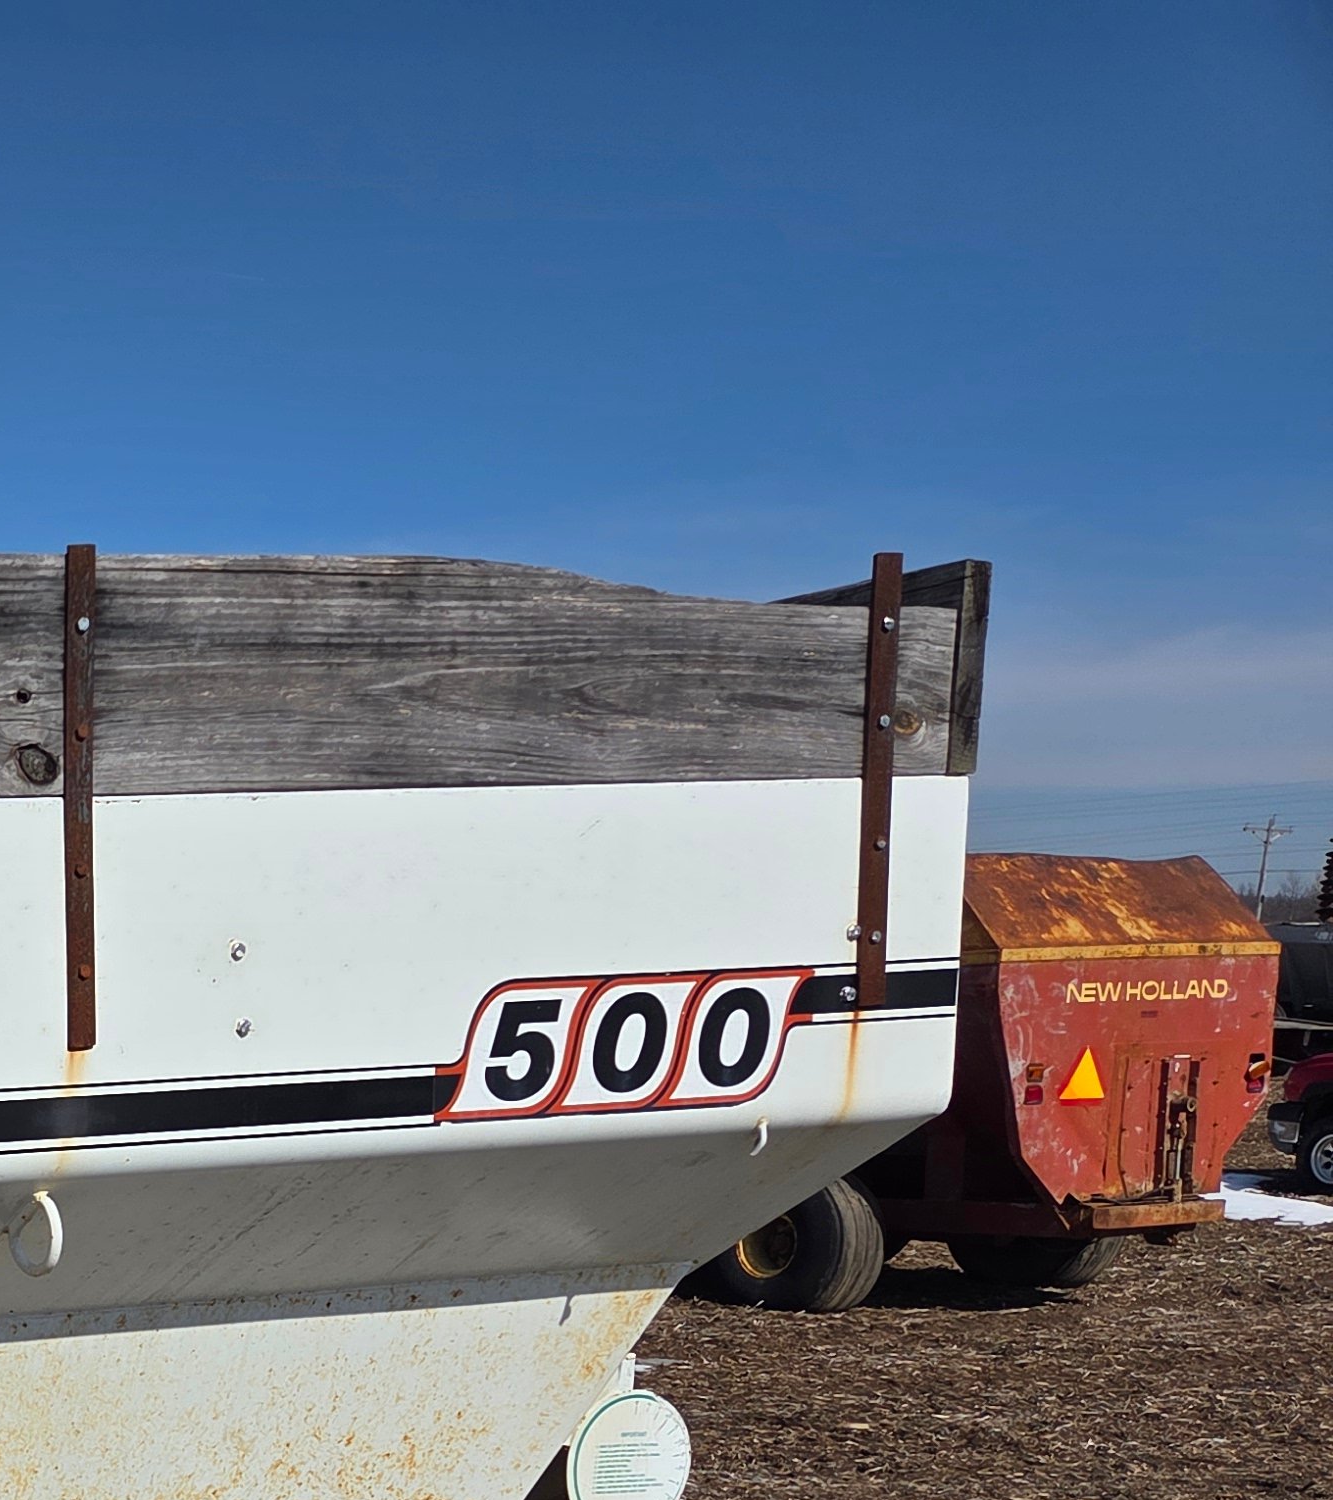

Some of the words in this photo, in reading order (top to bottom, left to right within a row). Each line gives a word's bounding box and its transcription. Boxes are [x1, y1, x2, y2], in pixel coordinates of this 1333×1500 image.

[1065, 981, 1122, 1004] NEW
[1125, 978, 1229, 1002] HOLLAND
[484, 986, 771, 1102] 500
